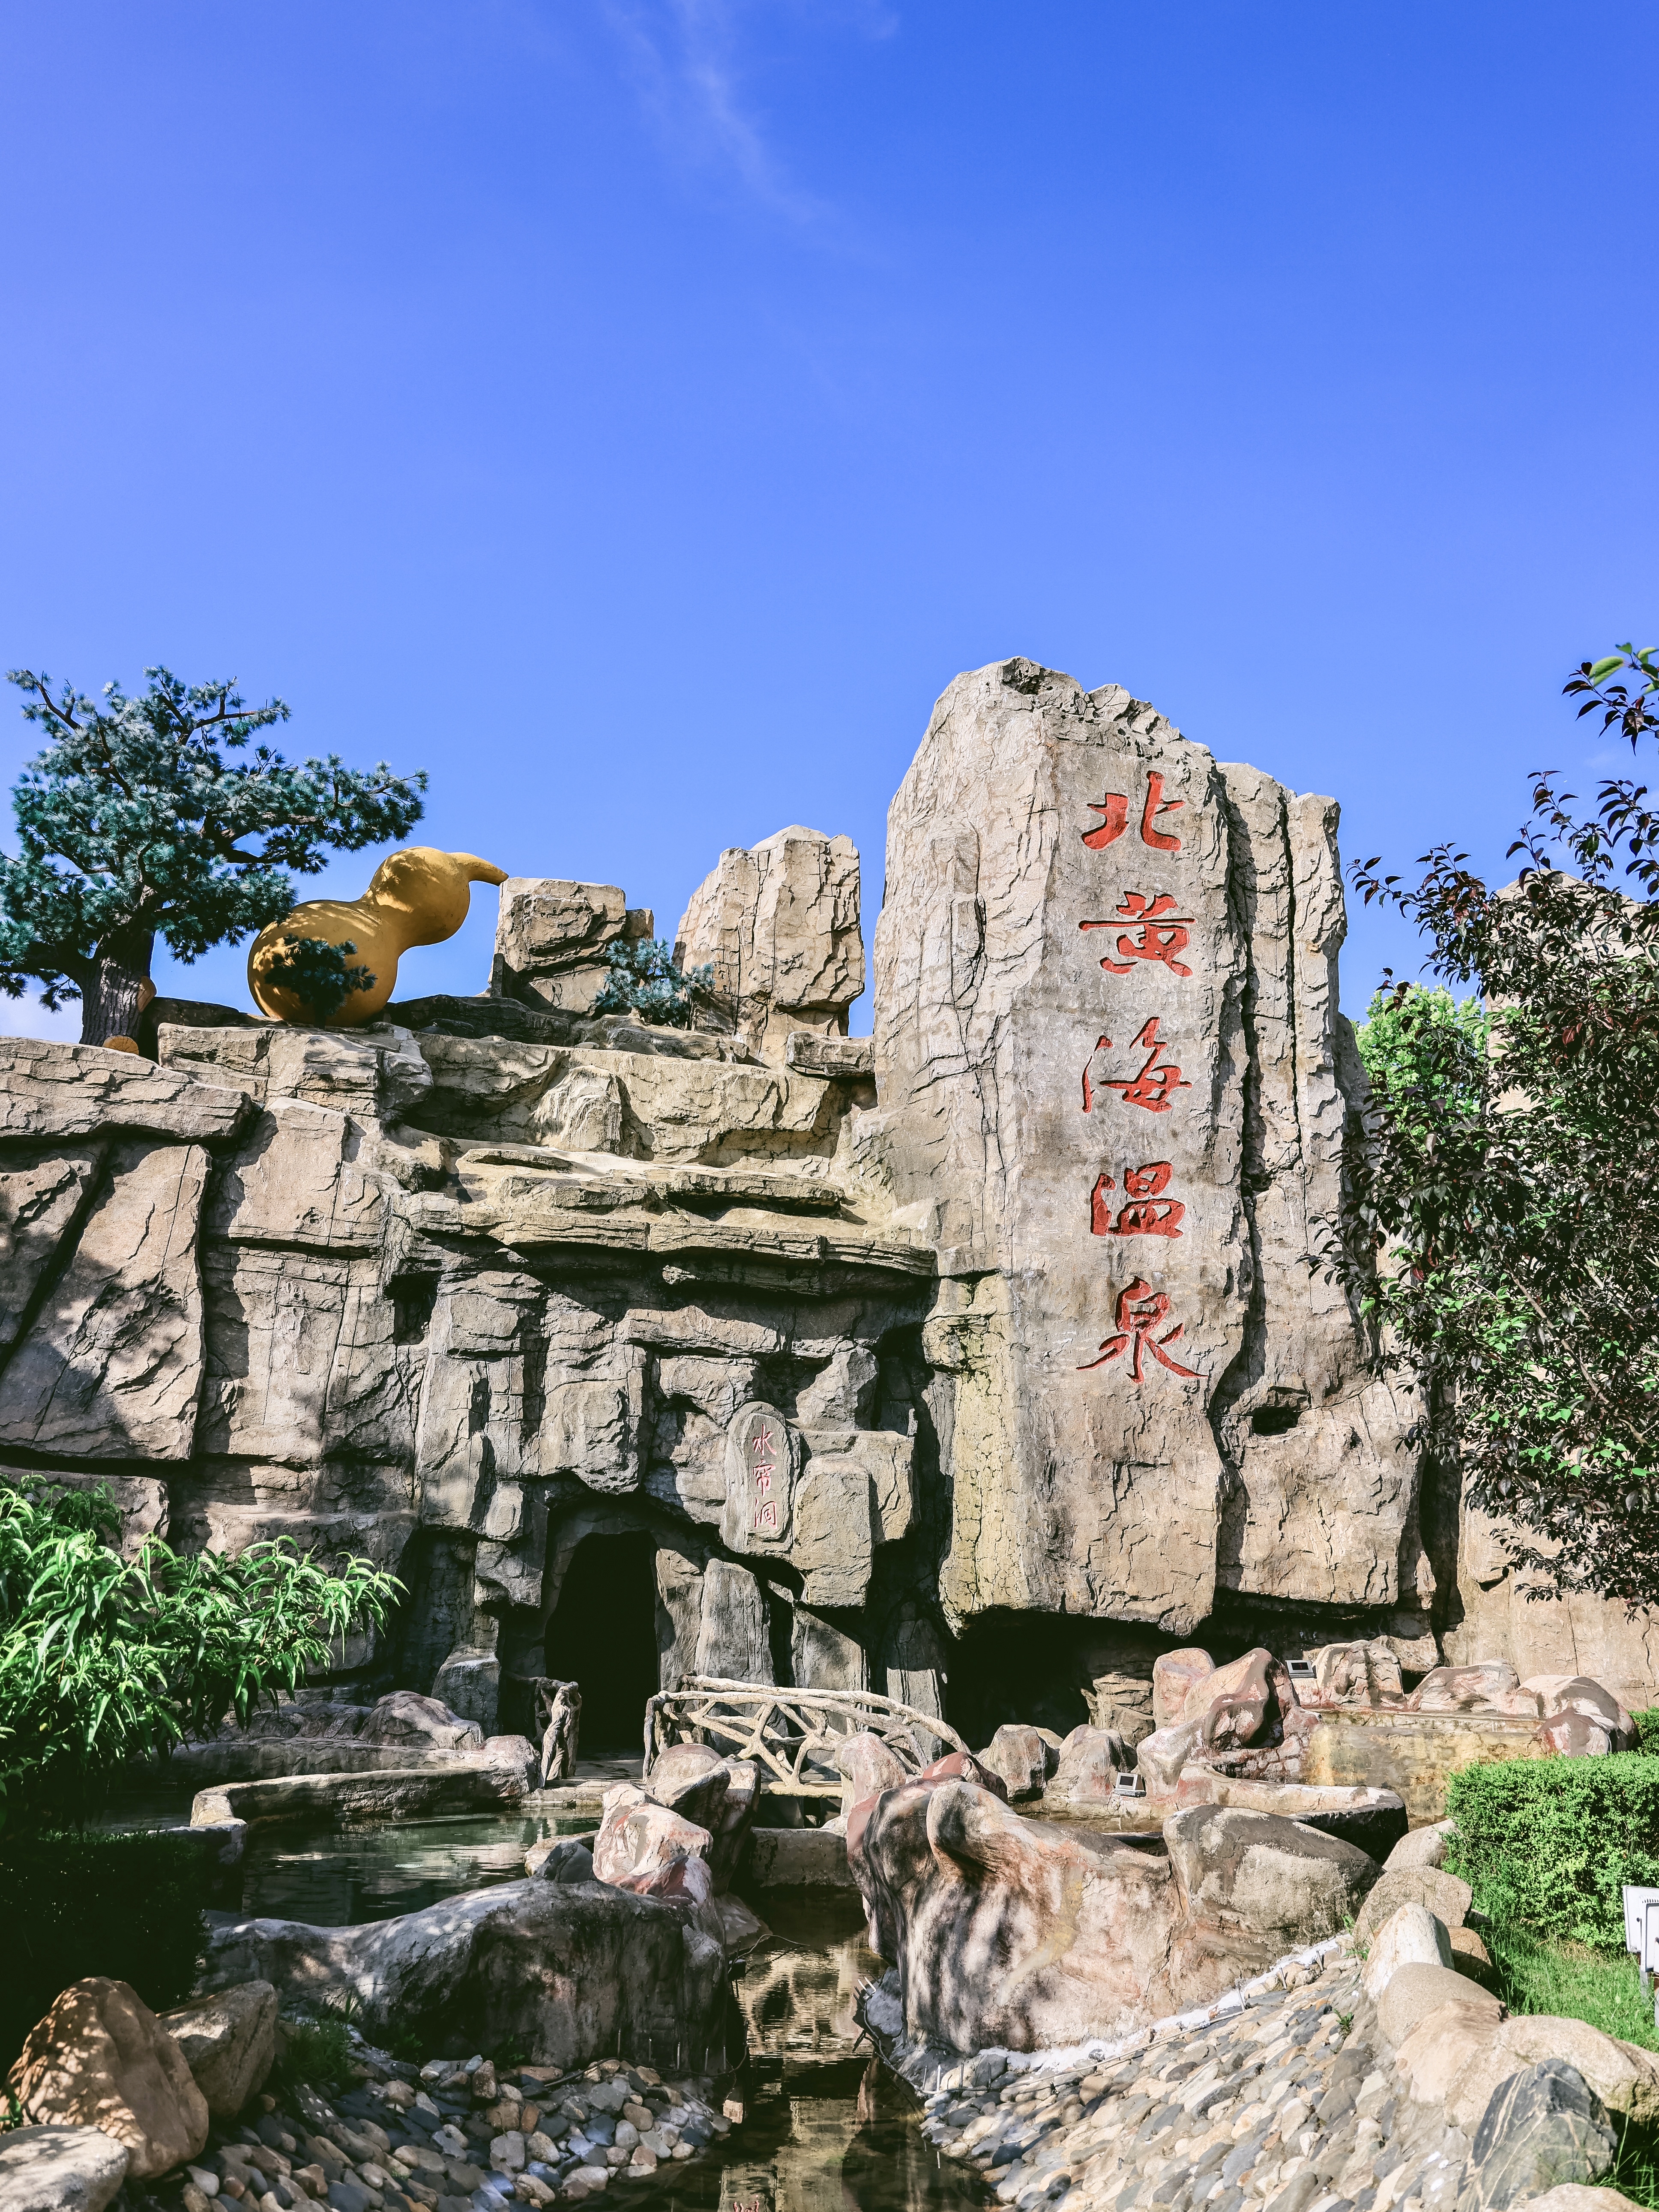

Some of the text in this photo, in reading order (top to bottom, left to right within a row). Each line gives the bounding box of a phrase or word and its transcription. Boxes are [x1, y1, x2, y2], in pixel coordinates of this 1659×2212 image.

[1076, 770, 1209, 1384] 北黄海温泉
[752, 1423, 777, 1529] 水帘洞
